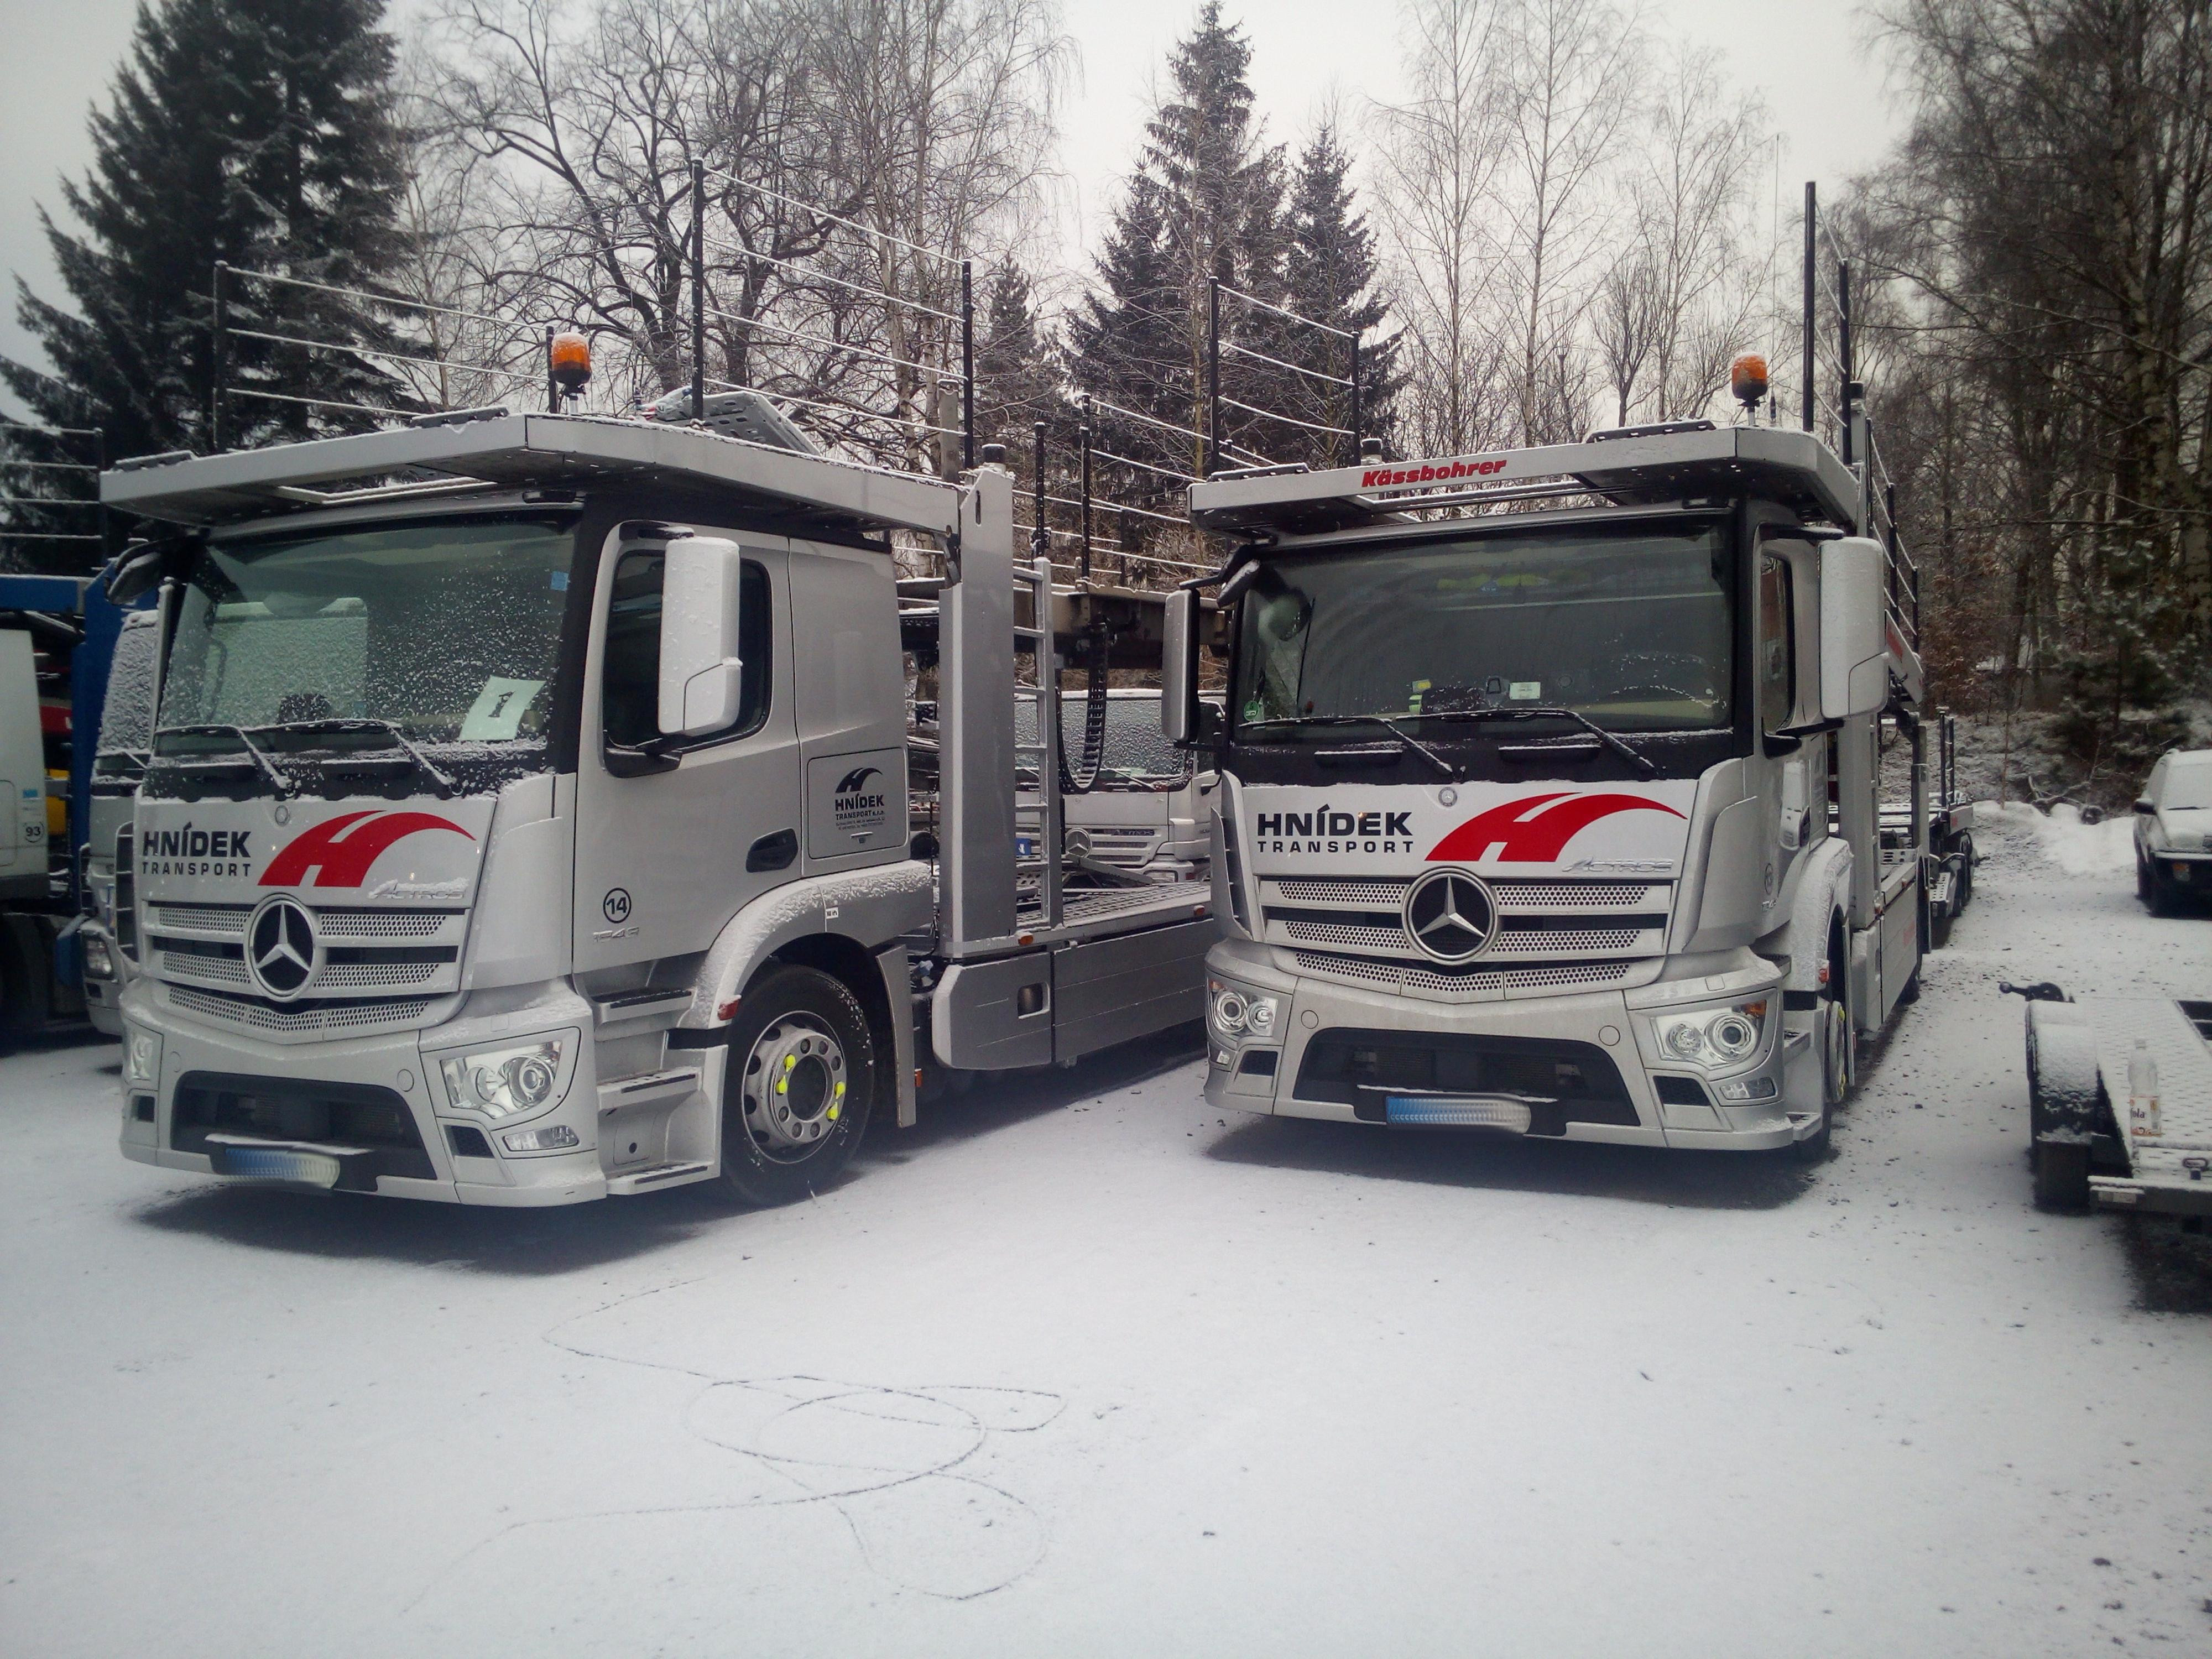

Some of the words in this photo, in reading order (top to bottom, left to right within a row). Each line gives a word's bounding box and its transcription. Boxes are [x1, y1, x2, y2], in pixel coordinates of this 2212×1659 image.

[1361, 460, 1507, 487] Kässbohrer
[834, 792, 884, 811] HNÍDEK
[836, 810, 872, 820] TRANSPORT
[1257, 804, 1413, 836] HNÍDEK
[25, 826, 41, 836] 93
[143, 821, 252, 858] HNÍDEK
[1257, 841, 1413, 853] TRANSPORT
[142, 862, 251, 877] TRANSPORT
[606, 896, 628, 915] 14
